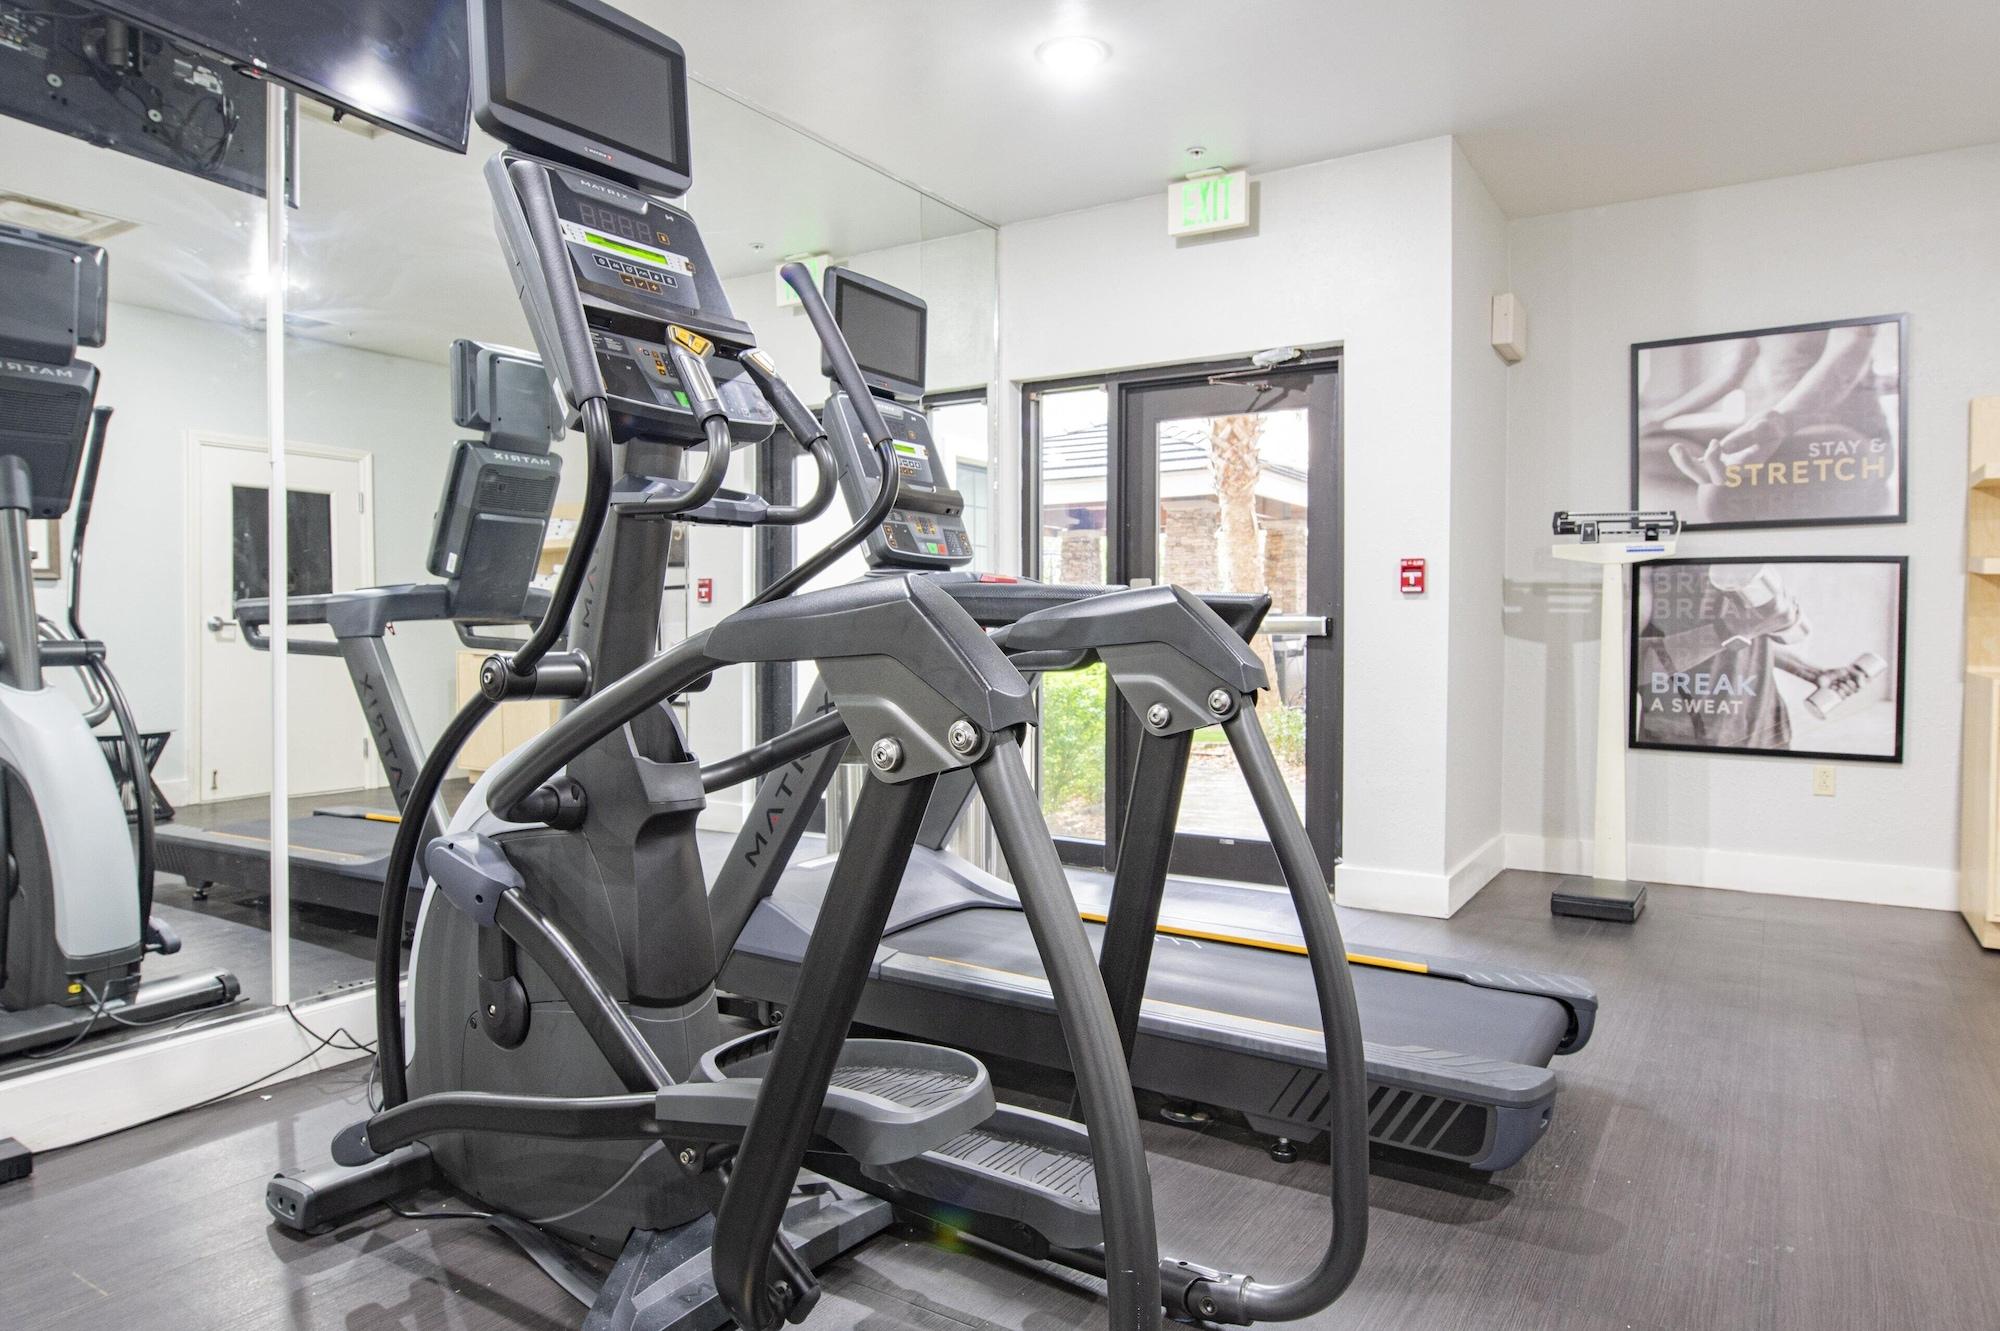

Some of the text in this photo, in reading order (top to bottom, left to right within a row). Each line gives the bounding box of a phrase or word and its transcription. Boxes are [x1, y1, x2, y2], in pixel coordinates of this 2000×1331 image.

[580, 179, 629, 200] MATRIX
[1183, 175, 1236, 227] EXIT
[1808, 438, 1886, 457] STAY &
[1725, 456, 1885, 488] STRETCH
[1651, 671, 1757, 697] BREAK
[1650, 697, 1744, 715] A SWEAT
[744, 690, 836, 869] MATX
